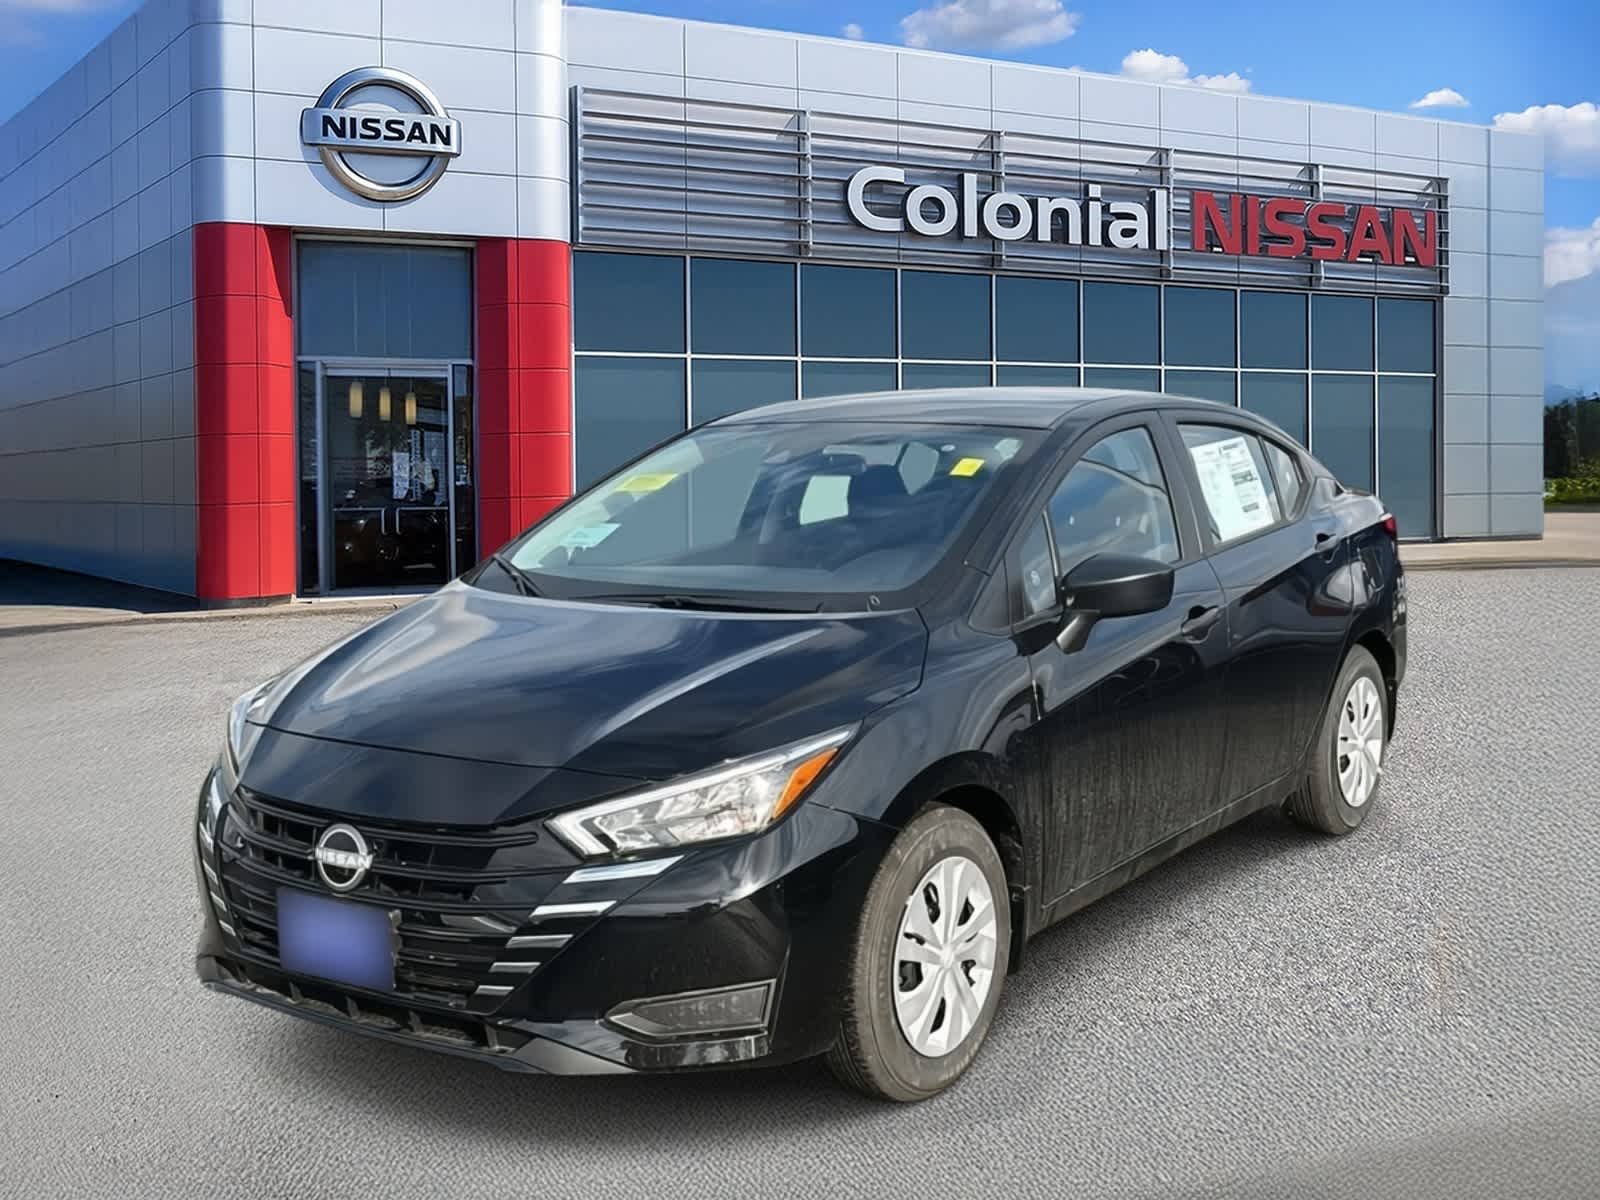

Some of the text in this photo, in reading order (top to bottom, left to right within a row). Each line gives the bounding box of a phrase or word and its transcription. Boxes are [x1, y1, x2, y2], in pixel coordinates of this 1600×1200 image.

[321, 115, 452, 146] NISSAN
[847, 165, 1437, 267] Colonial NISSAN
